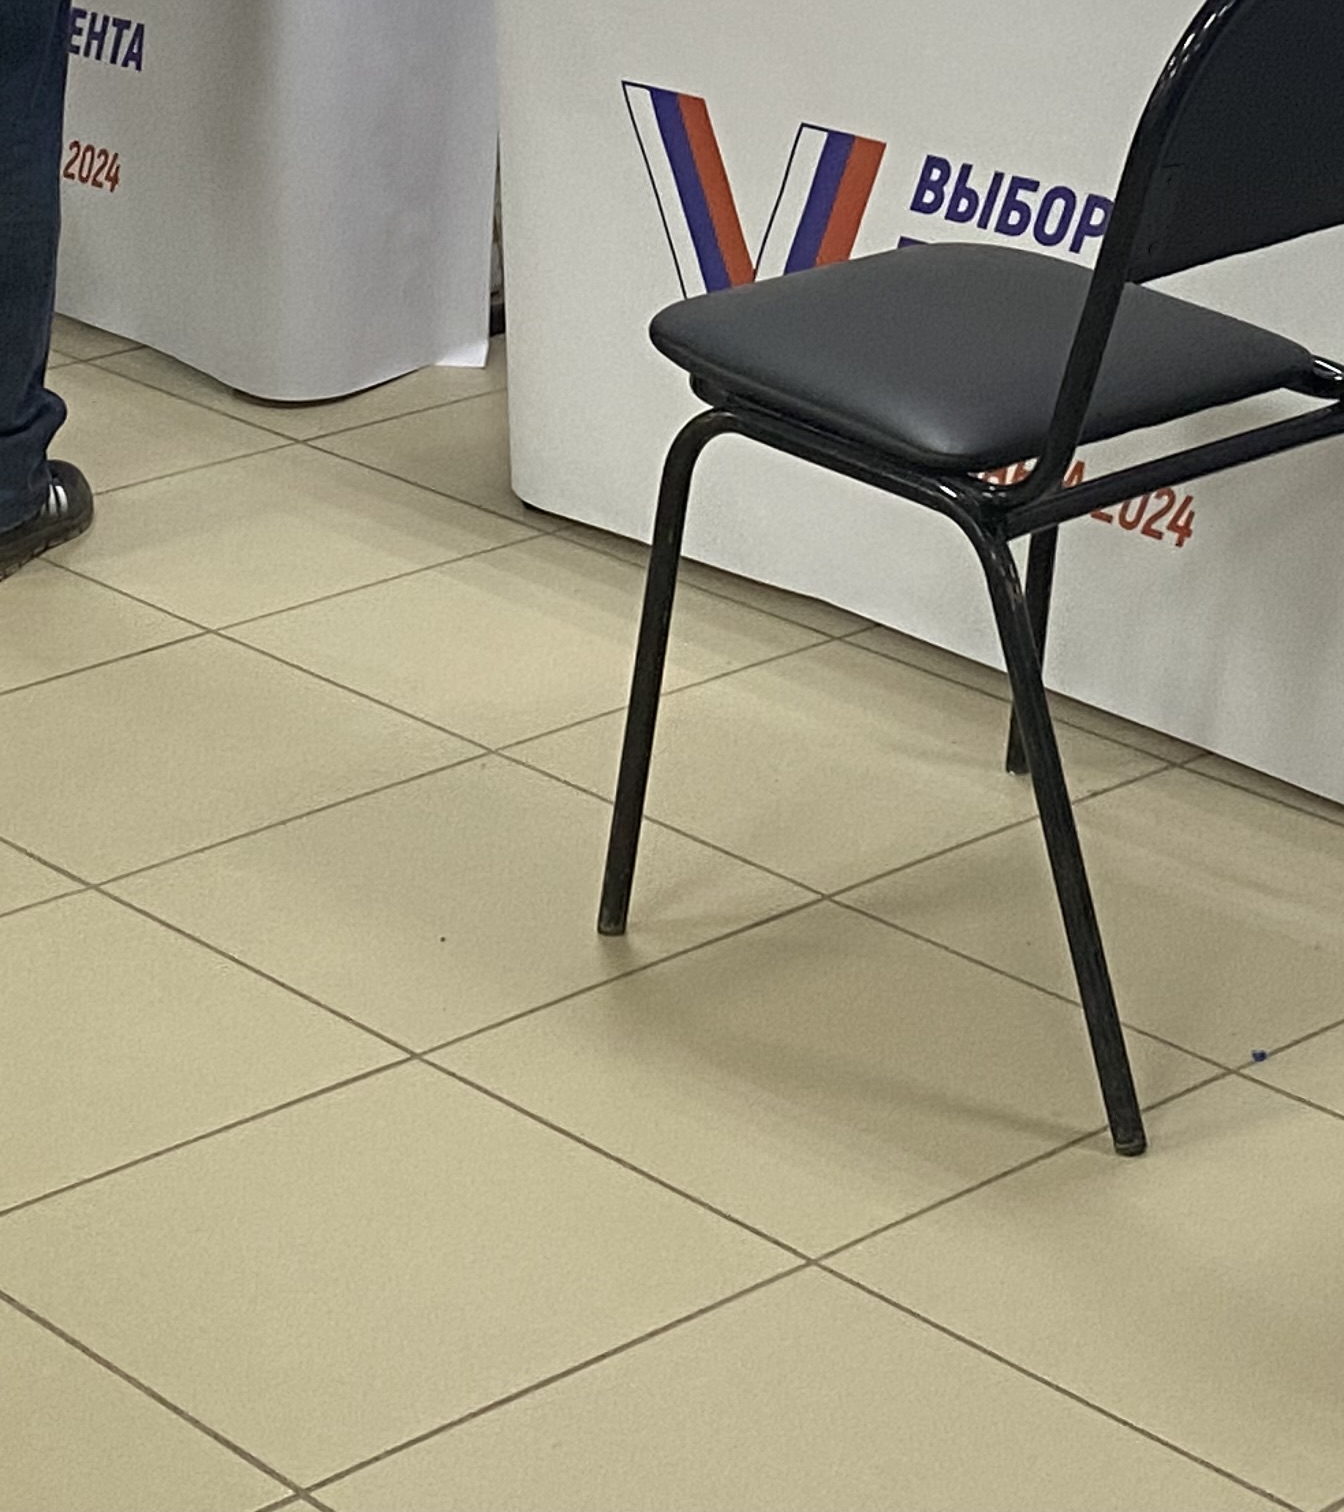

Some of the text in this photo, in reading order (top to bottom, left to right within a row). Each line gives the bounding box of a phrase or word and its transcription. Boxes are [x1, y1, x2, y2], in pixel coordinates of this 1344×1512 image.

[68, 7, 145, 72] ЕНТА
[63, 140, 120, 193] 2024
[909, 154, 1115, 254] ВЫБОР
